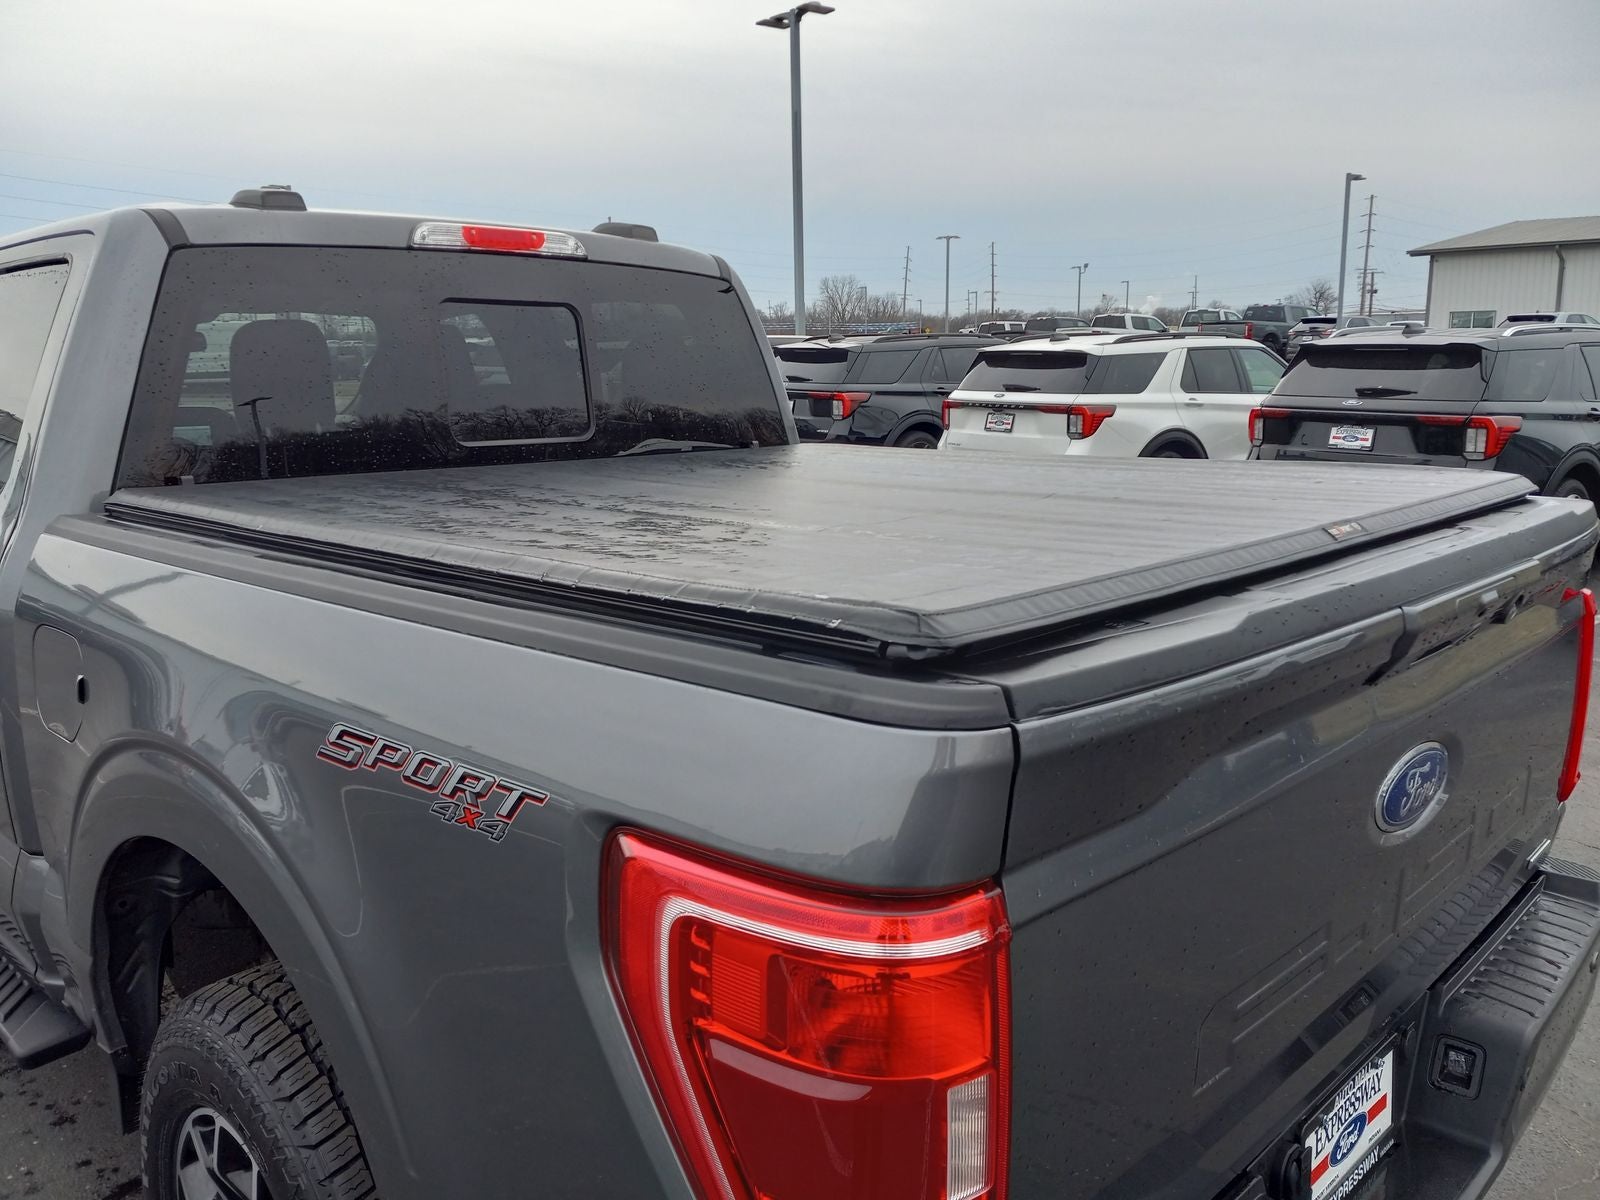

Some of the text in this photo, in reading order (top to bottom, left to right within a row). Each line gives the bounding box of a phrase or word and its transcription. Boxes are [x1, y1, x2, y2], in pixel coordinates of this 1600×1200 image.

[316, 722, 550, 822] SPORT
[1400, 761, 1440, 818] Ford
[1314, 1069, 1383, 1160] EXPRESSWAY
[1336, 1121, 1360, 1160] Ford
